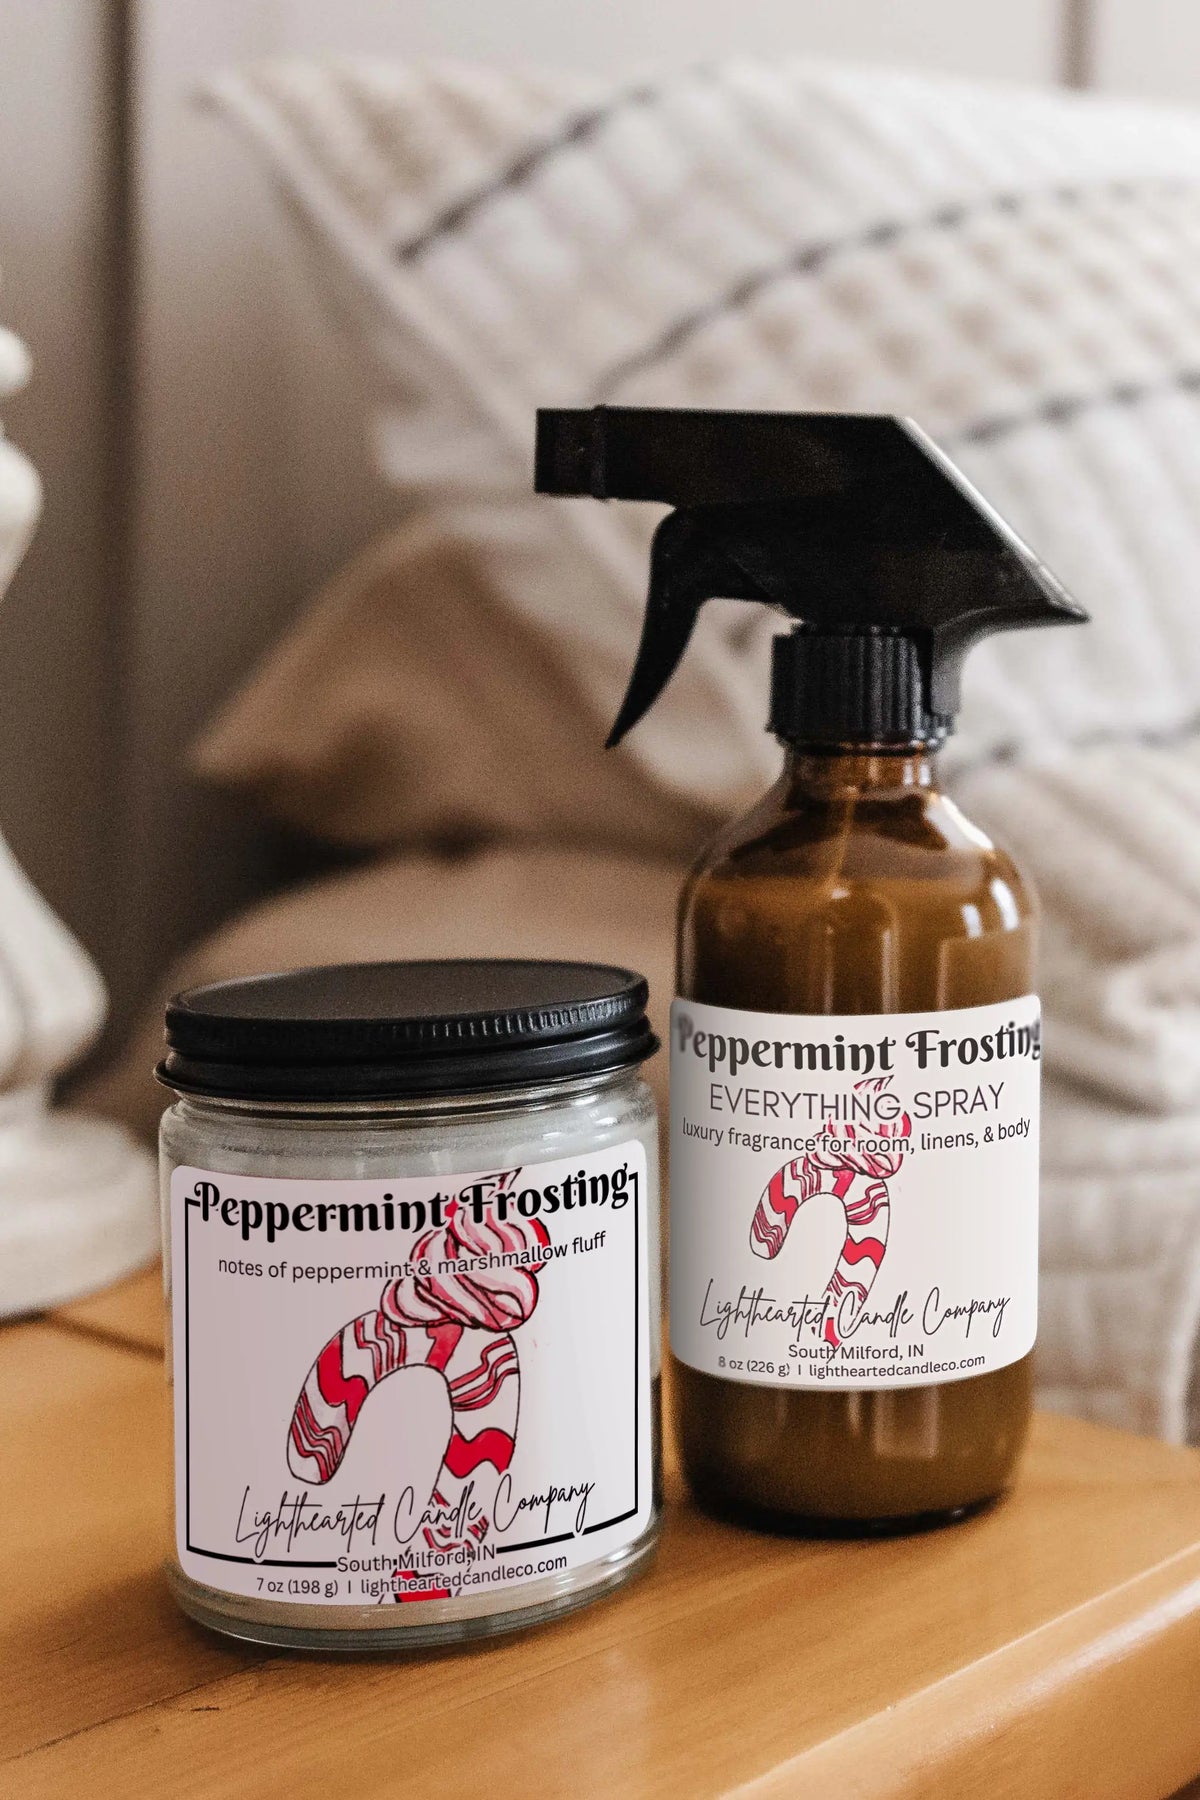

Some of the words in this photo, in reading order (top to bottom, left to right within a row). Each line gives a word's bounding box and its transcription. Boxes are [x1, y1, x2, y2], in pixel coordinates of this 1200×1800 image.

[678, 1013, 896, 1076] Peppermint
[710, 1083, 901, 1121] EVERYTHING
[913, 1082, 1005, 1119] SPRAY
[683, 1117, 724, 1146] luxury
[727, 1127, 816, 1152] fragrance
[821, 1134, 852, 1152] for
[858, 1137, 915, 1154] room,
[921, 1131, 978, 1151] linens,
[983, 1127, 995, 1143] &
[999, 1116, 1031, 1140] body
[193, 1181, 452, 1243] Peppermint
[459, 1163, 629, 1224] Frosting
[218, 1258, 262, 1278] notes
[267, 1261, 288, 1278] of
[293, 1261, 412, 1284] peppermint
[420, 1258, 433, 1276] &
[438, 1241, 568, 1272] marshmallow
[572, 1230, 606, 1254] fluff
[700, 1278, 830, 1342] Lighthearted
[837, 1290, 914, 1339] Candle
[922, 1286, 1010, 1338] Company
[718, 1356, 726, 1368] 8
[729, 1360, 743, 1370] oz
[747, 1360, 775, 1375] (226
[778, 1362, 791, 1378] g)
[809, 1354, 986, 1379] lightheartedcandleco.com
[788, 1344, 836, 1359] South
[841, 1344, 904, 1361] Milford,
[908, 1344, 924, 1357] IN
[236, 1485, 386, 1558] Lighthearted
[394, 1480, 482, 1543] Candle
[494, 1474, 595, 1534] Company
[256, 1578, 264, 1591] 7
[267, 1582, 284, 1593] oz
[288, 1578, 321, 1596] (198
[324, 1579, 339, 1598] g)
[360, 1557, 568, 1595] lightheartedcandleco.com
[338, 1555, 392, 1573] South
[399, 1548, 472, 1570] Milford,
[477, 1546, 496, 1561] IN
